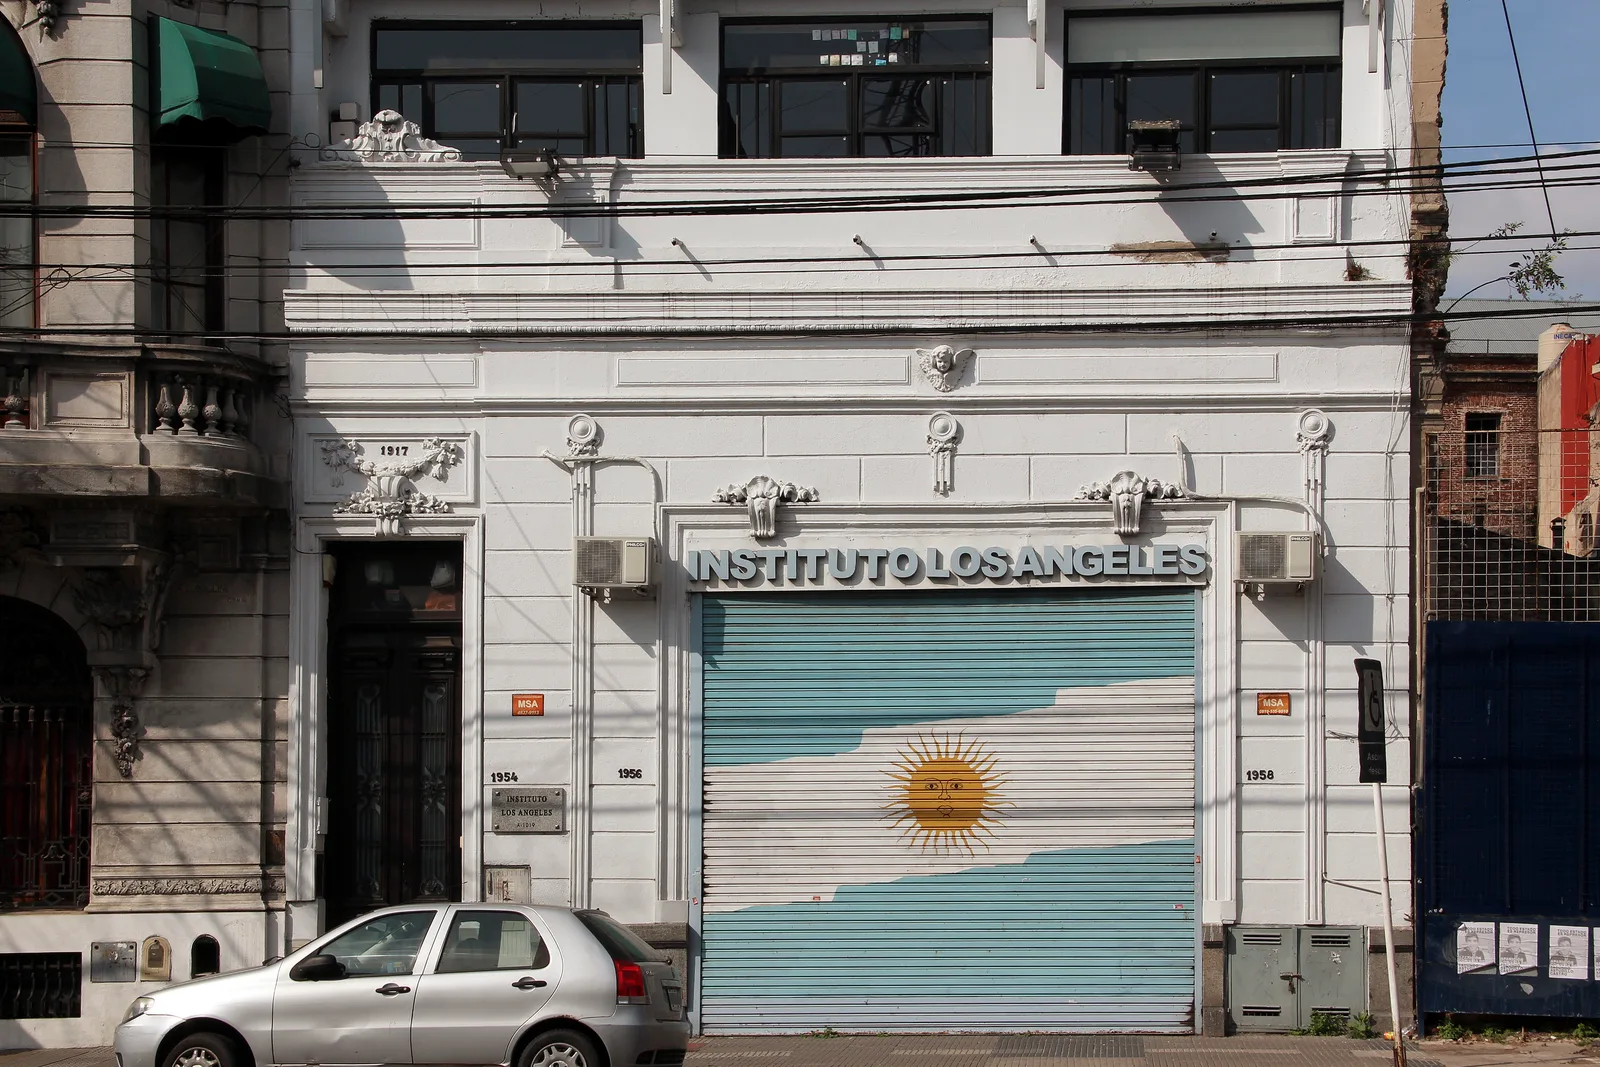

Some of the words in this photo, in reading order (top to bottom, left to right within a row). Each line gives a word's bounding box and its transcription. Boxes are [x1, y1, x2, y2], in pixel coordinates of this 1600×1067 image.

[380, 445, 409, 457] 1917
[687, 546, 920, 581] INSTITUTO
[925, 545, 1010, 580] LOS
[1012, 544, 1207, 579] ANGELES
[517, 699, 539, 708] MSA
[1262, 698, 1284, 707] MSA
[490, 771, 519, 783] 1954
[617, 768, 643, 779] 1956
[1246, 769, 1275, 781] 1958
[506, 795, 548, 803] INSTITUTO
[501, 809, 516, 817] LOS
[517, 809, 553, 817] ANGELES
